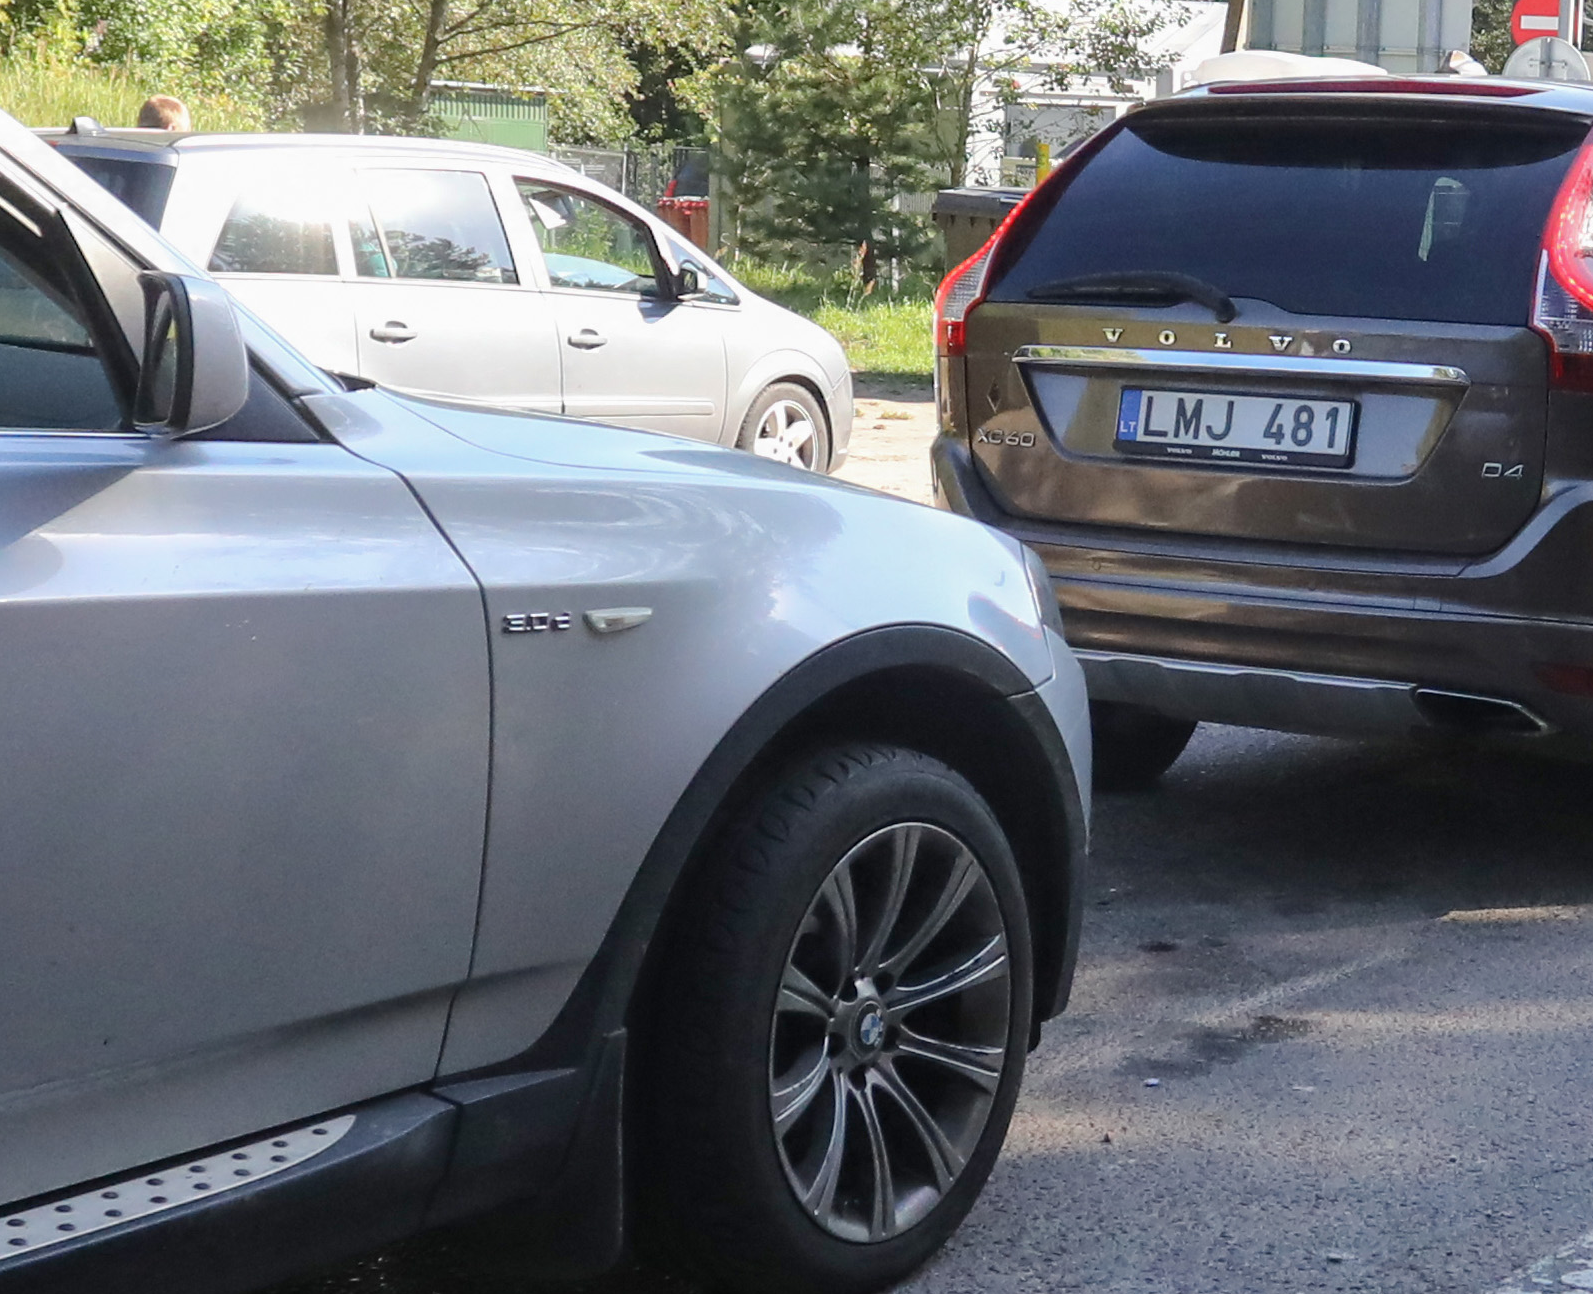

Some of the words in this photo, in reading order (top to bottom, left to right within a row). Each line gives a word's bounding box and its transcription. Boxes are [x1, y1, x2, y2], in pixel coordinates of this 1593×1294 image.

[1102, 327, 1352, 355] VOLVO
[1119, 420, 1137, 434] LT
[1142, 395, 1236, 442] LMJ
[1262, 402, 1341, 450] 481
[1481, 462, 1524, 480] D4
